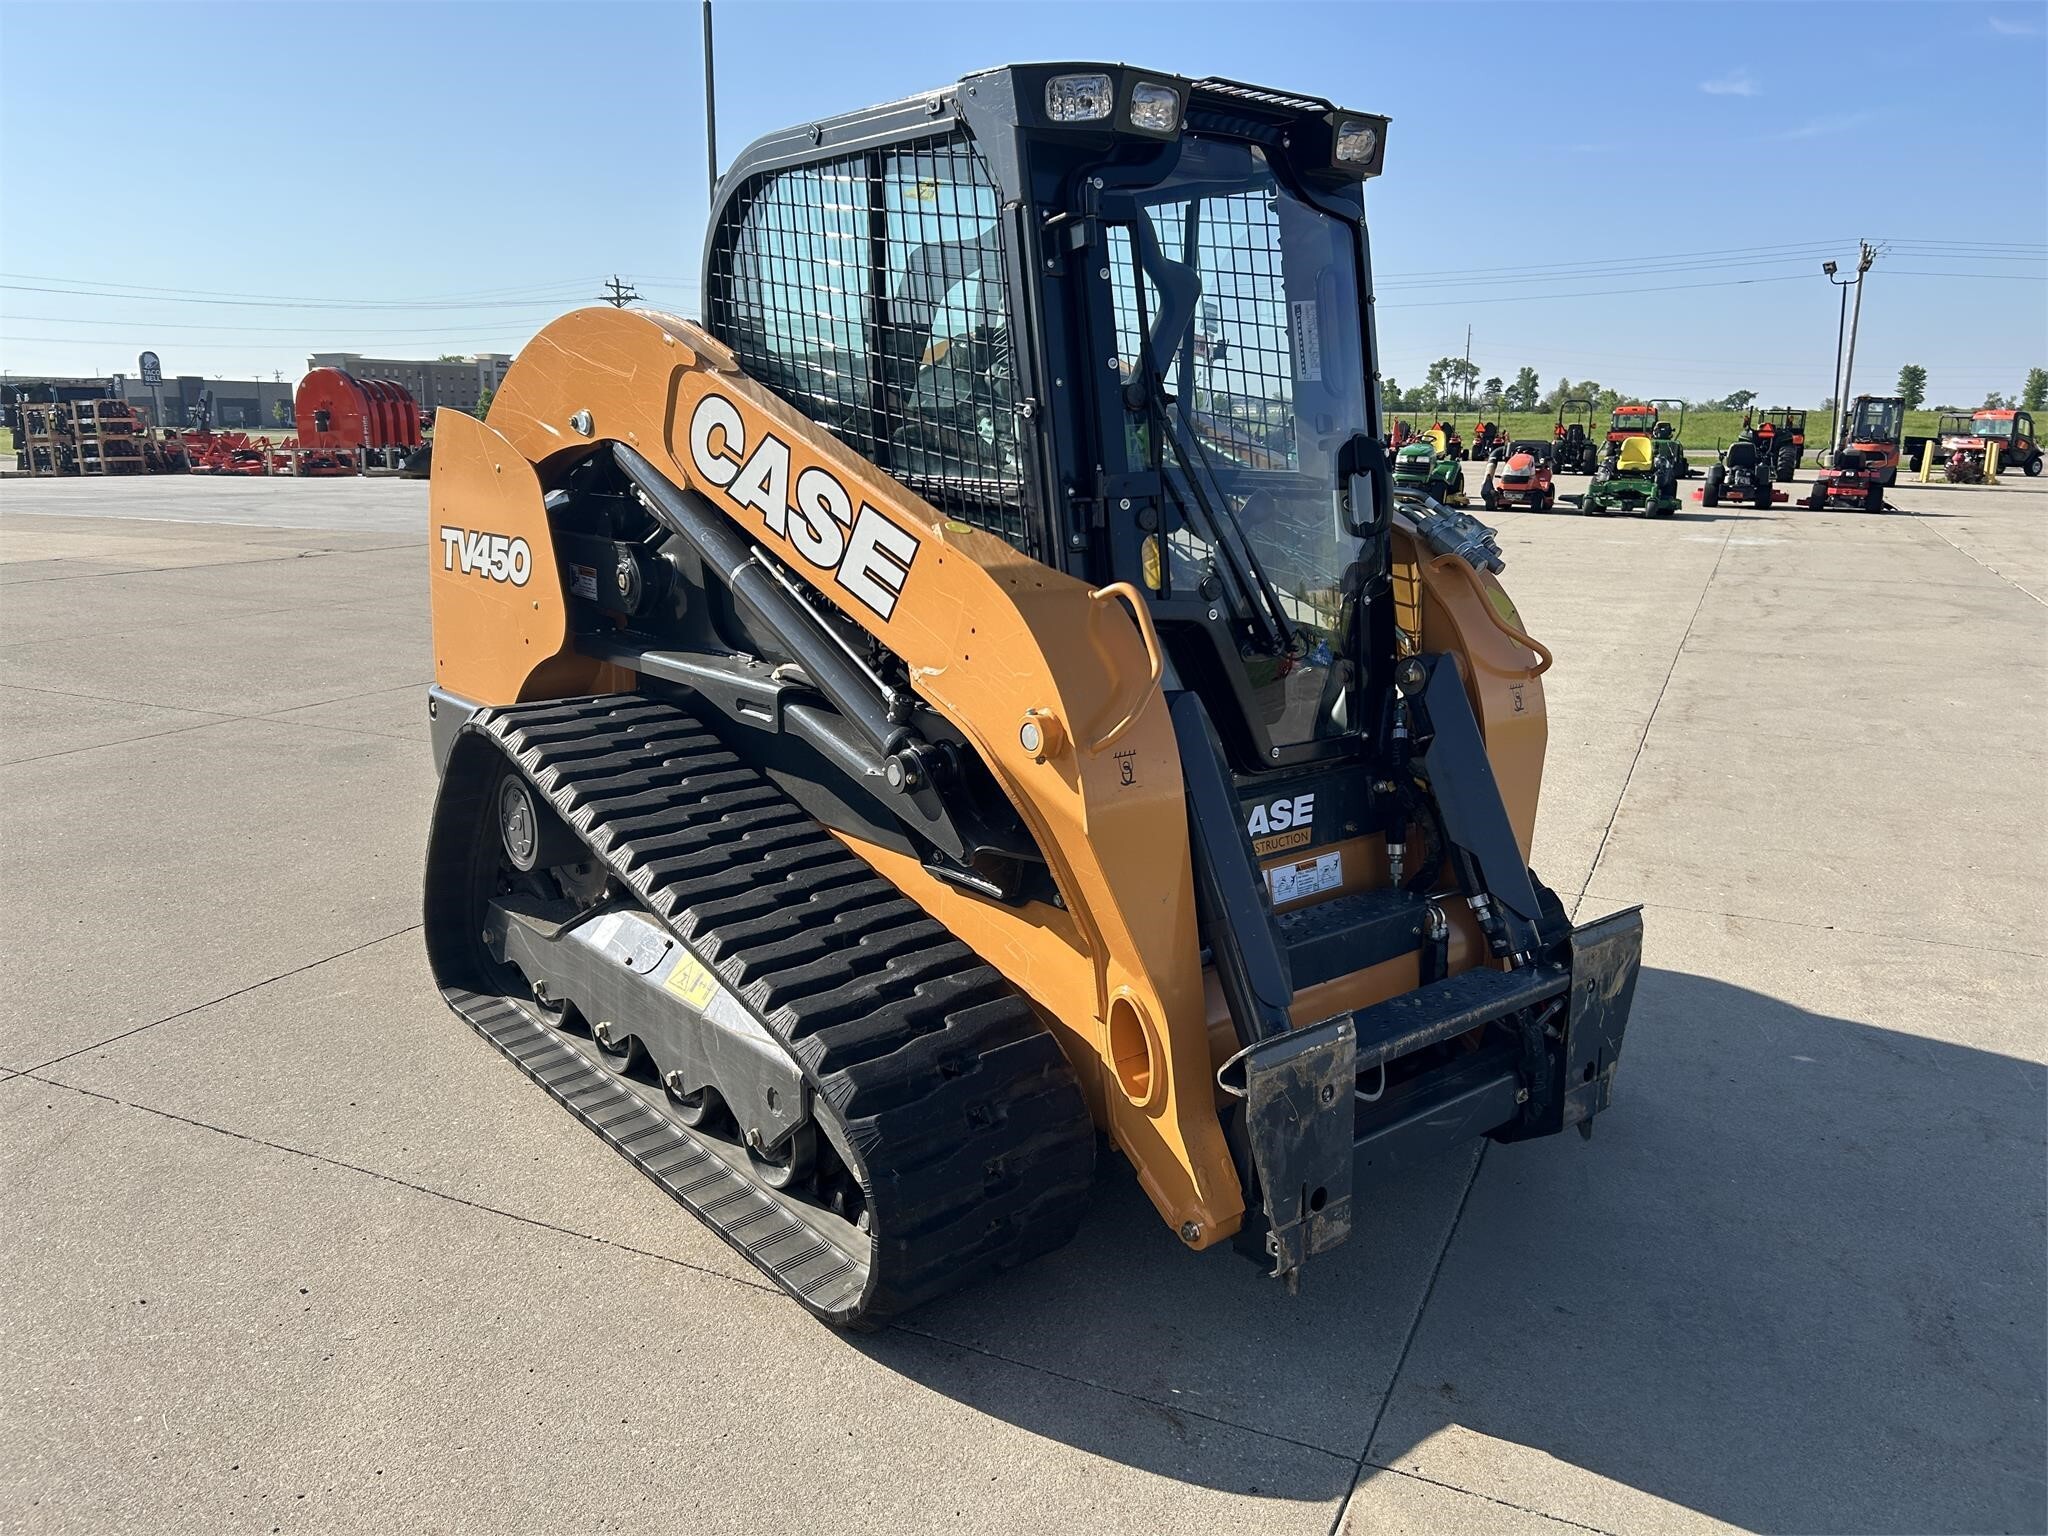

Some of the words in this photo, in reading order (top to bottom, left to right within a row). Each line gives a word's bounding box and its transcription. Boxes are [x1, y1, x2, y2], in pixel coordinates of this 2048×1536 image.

[690, 393, 921, 623] CASE
[441, 525, 532, 587] TV450
[1247, 793, 1314, 837] ASE
[1255, 832, 1308, 853] STRUCTION
